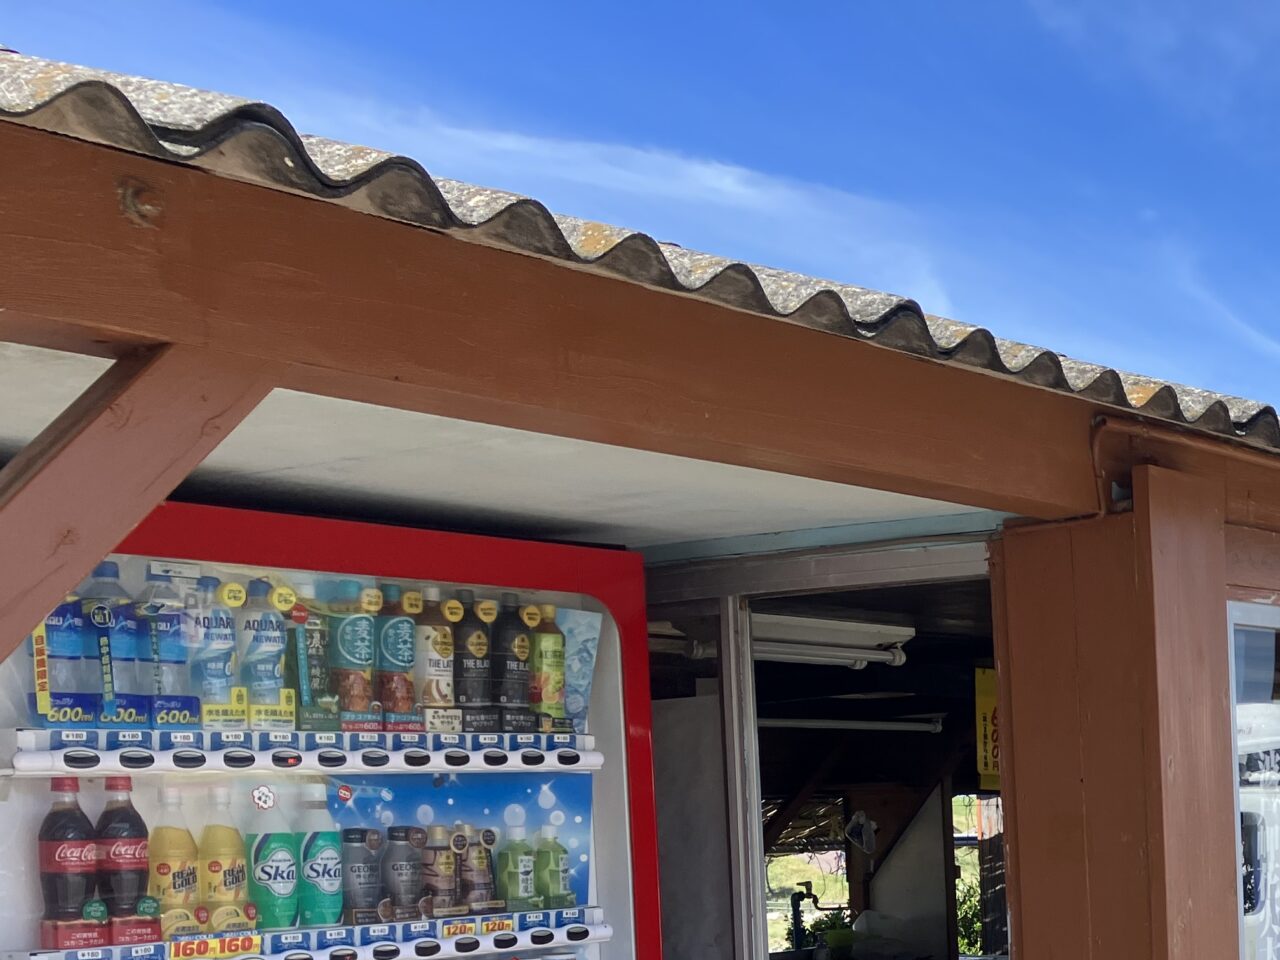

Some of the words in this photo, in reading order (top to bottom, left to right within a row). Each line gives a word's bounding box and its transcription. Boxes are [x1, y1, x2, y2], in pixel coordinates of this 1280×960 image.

[354, 619, 371, 660] 麦茶
[397, 622, 413, 662] 麦茶
[428, 658, 440, 669] THE
[463, 659, 476, 668] THE
[506, 661, 518, 671] THE
[156, 710, 199, 724] 600ml
[172, 866, 198, 881] REAL
[223, 864, 246, 879] REAL
[445, 924, 474, 936] 120円
[484, 920, 513, 932] 120円
[174, 940, 216, 958] 160円
[219, 936, 259, 953] 160円
